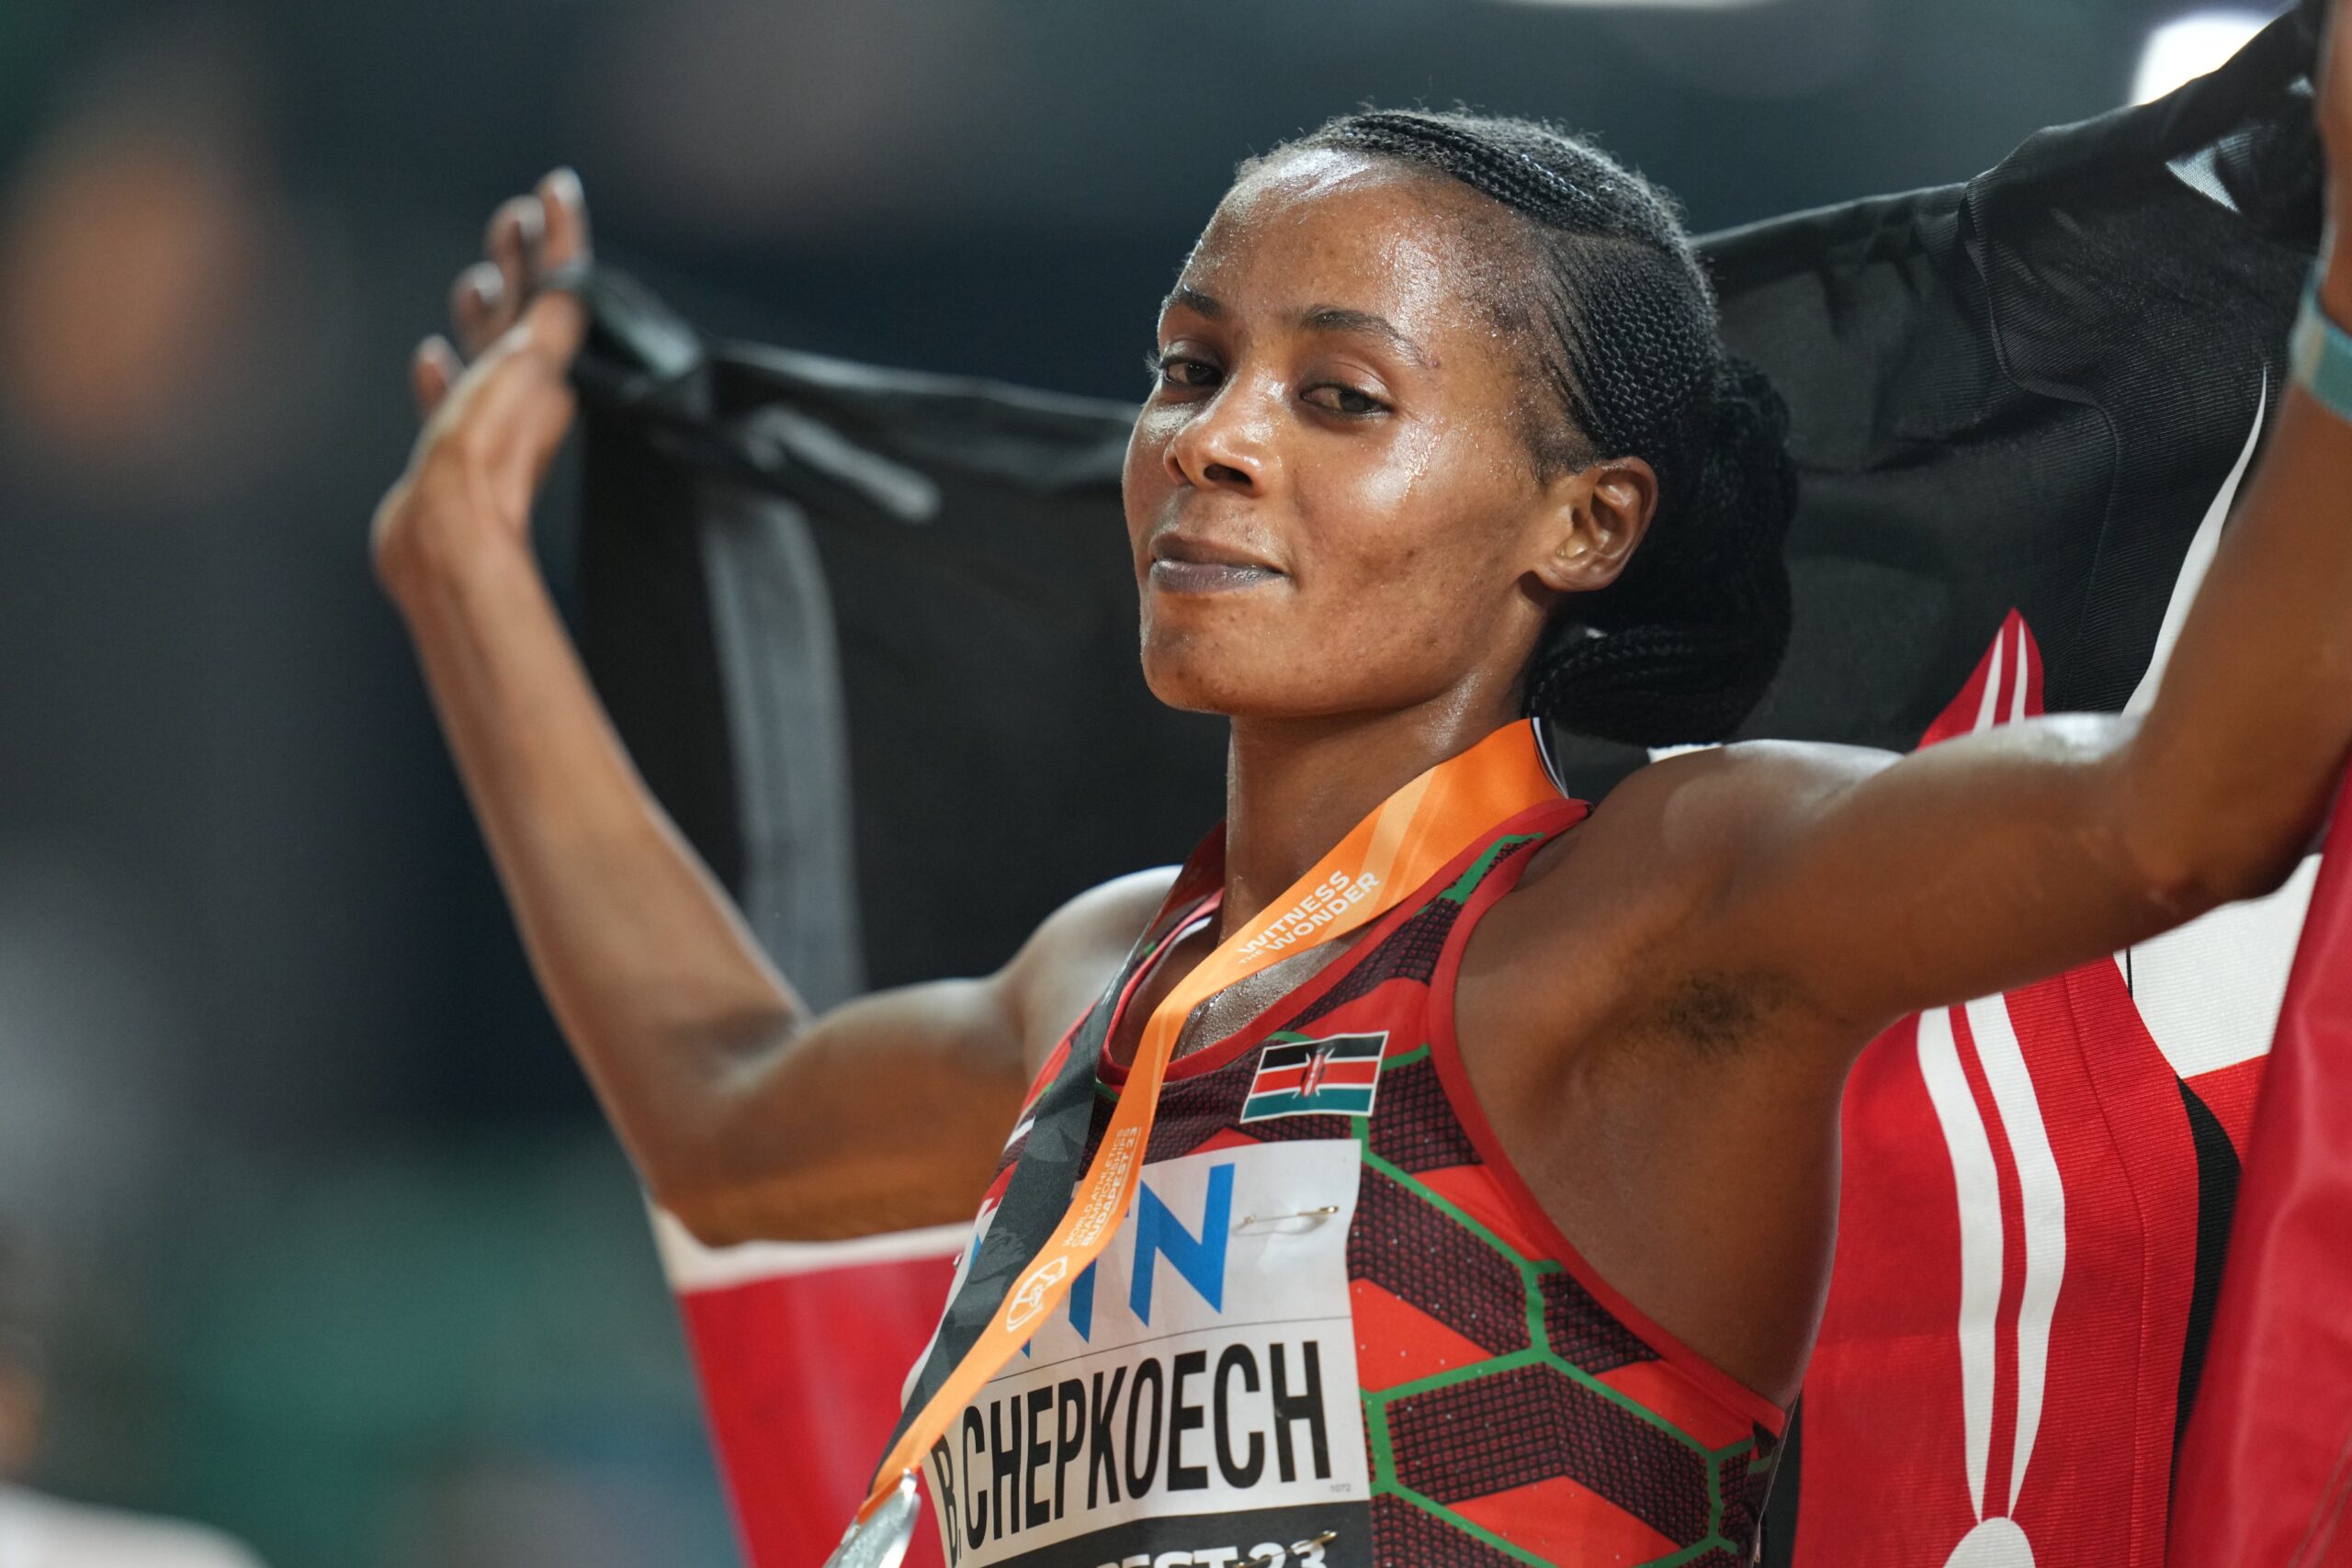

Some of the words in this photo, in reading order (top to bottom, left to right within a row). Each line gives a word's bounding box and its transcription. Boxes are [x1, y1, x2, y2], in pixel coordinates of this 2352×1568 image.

[1237, 870, 1351, 954] WITNESS
[1238, 948, 1268, 964] THE
[1266, 872, 1381, 951] WONDER
[1061, 1203, 1093, 1247] WORLD
[1091, 1128, 1124, 1201] ATHLETICS
[1071, 1128, 1130, 1247] CHAMPIONSHIPS
[1080, 1152, 1129, 1247] BUDAPEST
[1125, 1126, 1137, 1147] 23
